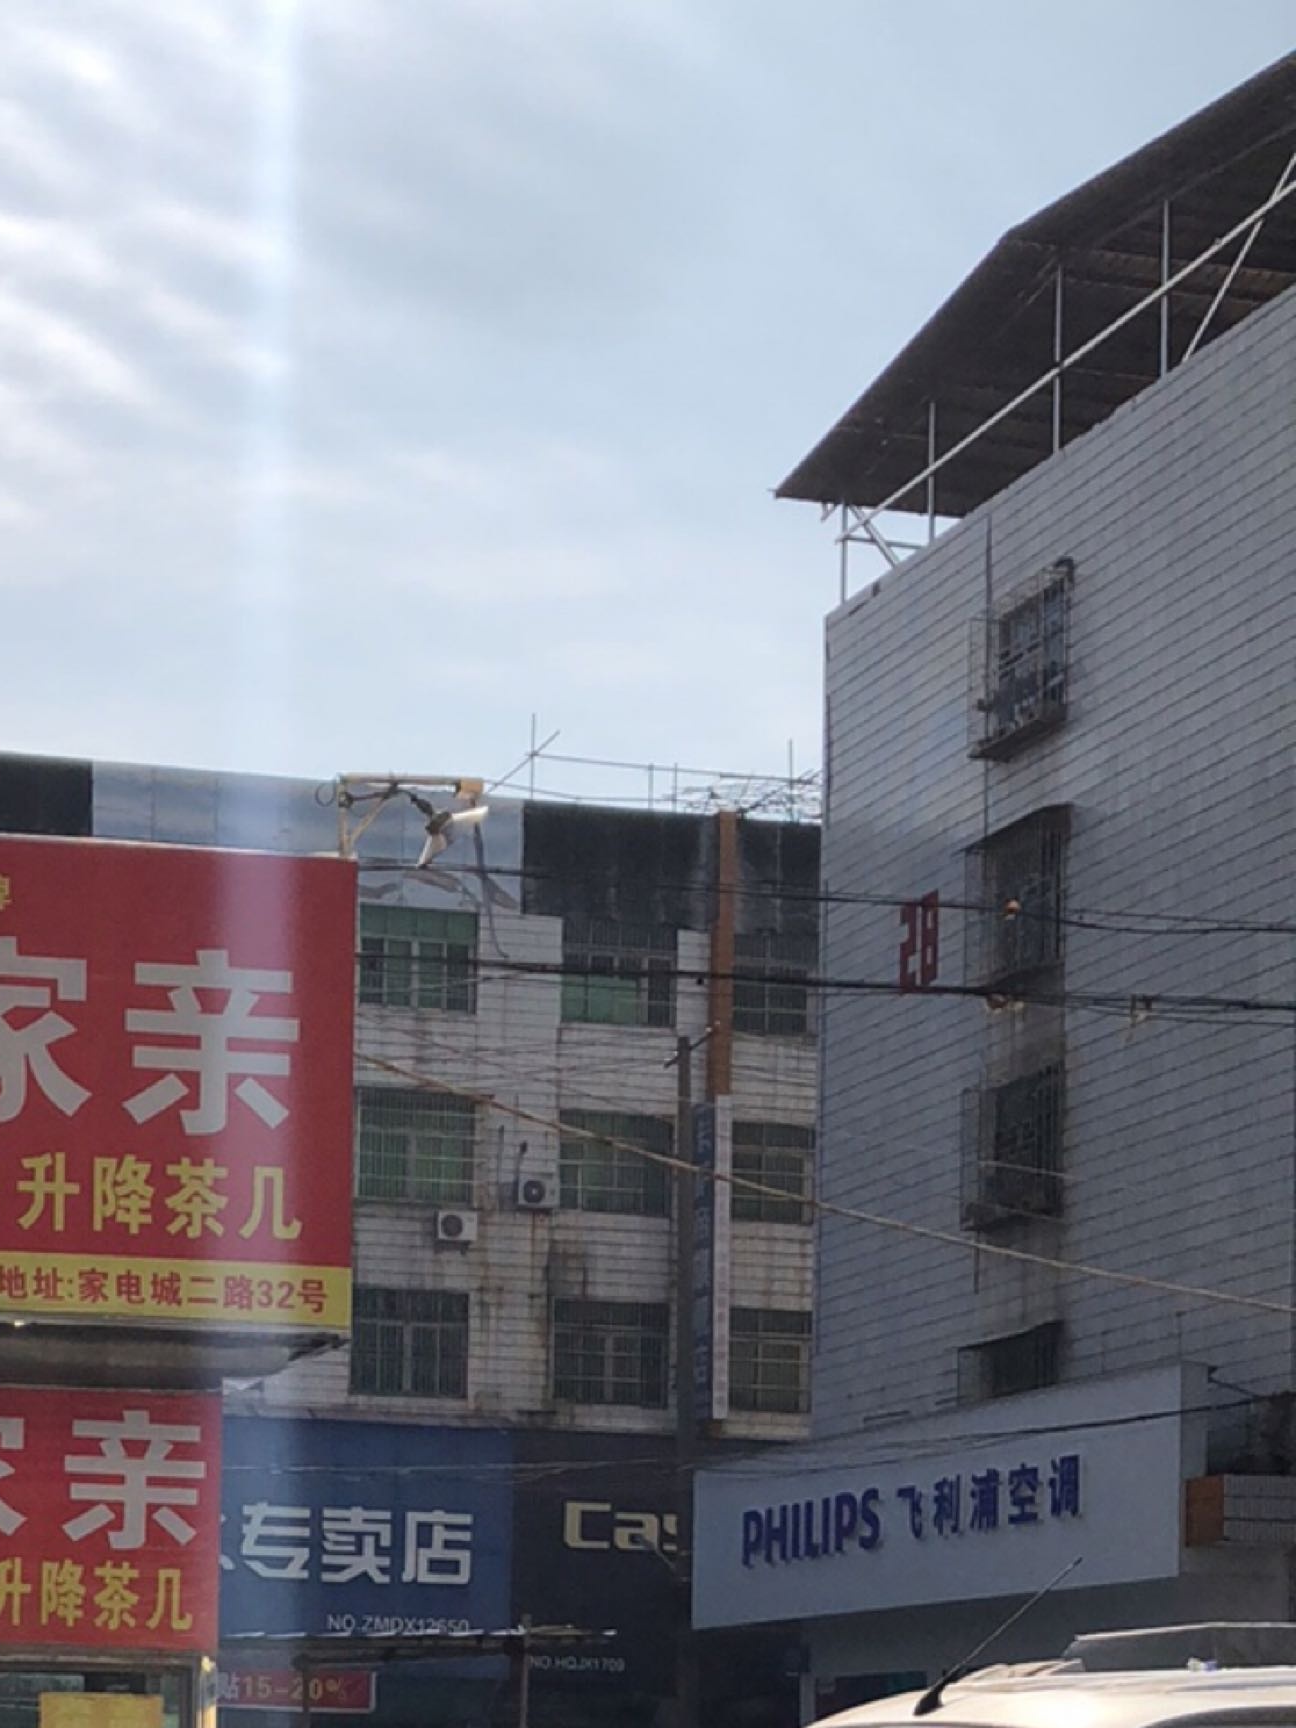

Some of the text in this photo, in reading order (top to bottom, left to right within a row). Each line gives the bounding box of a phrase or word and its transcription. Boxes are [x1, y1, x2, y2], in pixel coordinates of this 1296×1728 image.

[17, 1152, 303, 1242] 升降茶几
[219, 1502, 474, 1585] 专卖店
[742, 1454, 1084, 1568] PHILIPS 飞利浦空调
